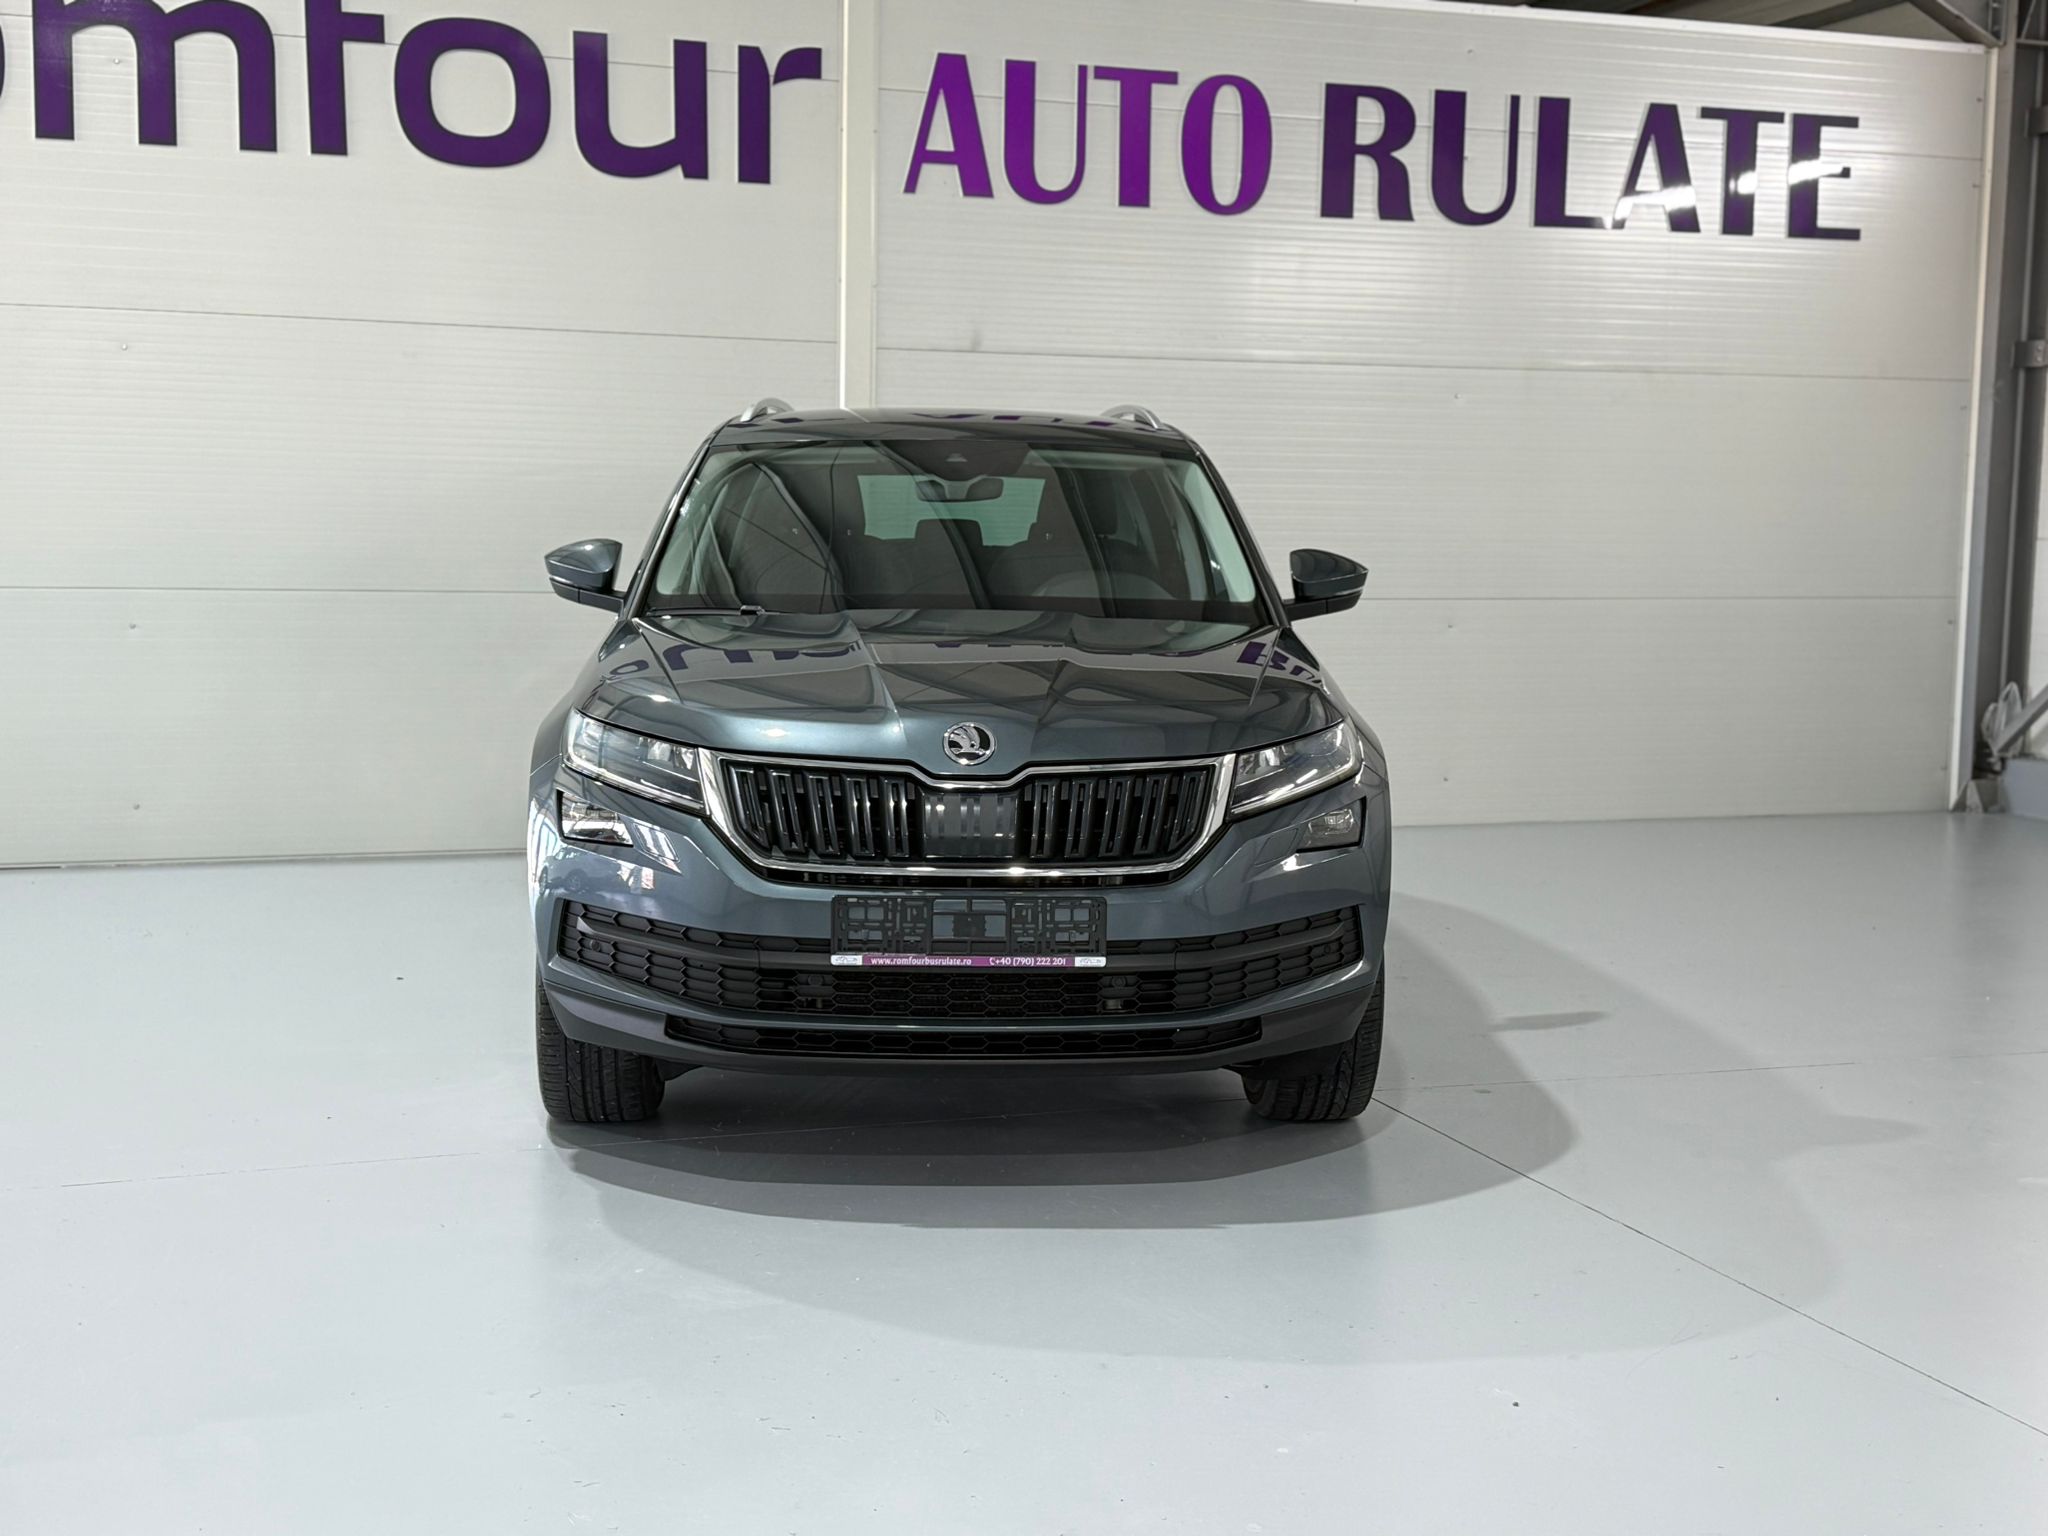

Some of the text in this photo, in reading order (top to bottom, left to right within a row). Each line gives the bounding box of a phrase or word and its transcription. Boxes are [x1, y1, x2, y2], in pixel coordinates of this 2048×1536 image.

[0, 0, 822, 185] mfour
[903, 52, 1862, 241] AUTO RULATE
[870, 956, 972, 966] www.romfourbusrulate.ro
[1013, 956, 1035, 967] (790)
[1036, 957, 1051, 966] 222
